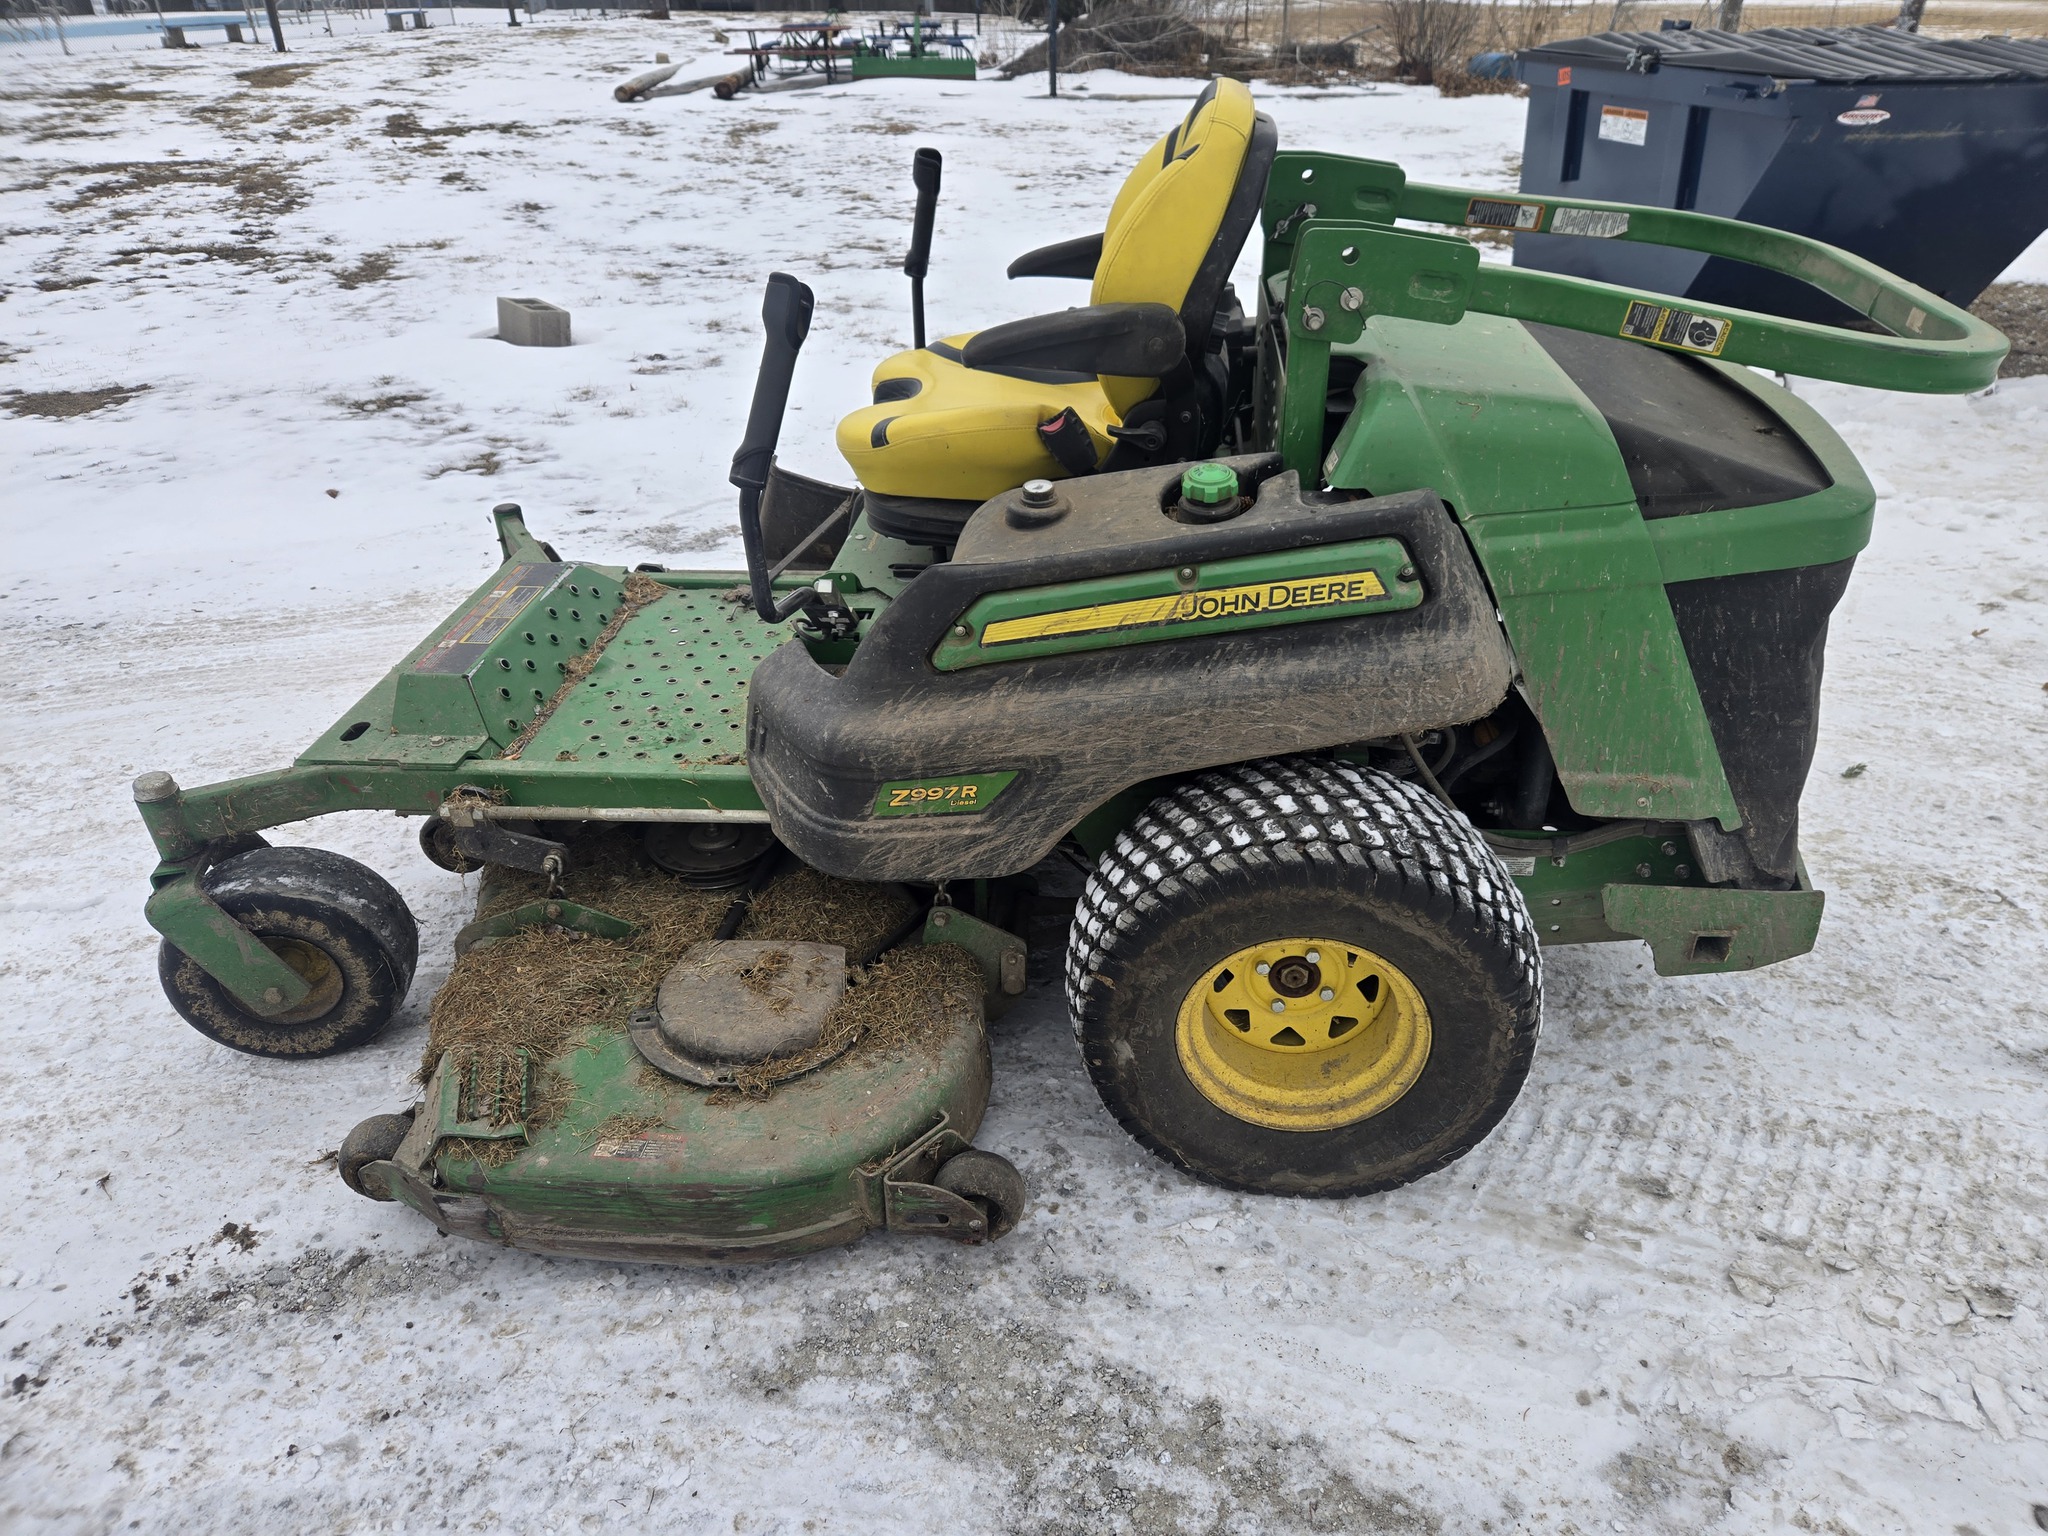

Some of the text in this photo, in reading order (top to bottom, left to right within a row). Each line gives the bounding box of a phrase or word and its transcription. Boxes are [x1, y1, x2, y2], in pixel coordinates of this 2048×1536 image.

[1715, 326, 1729, 352] CAUTION
[1182, 580, 1365, 618] JOHN DEERE
[888, 785, 979, 807] Z997R
